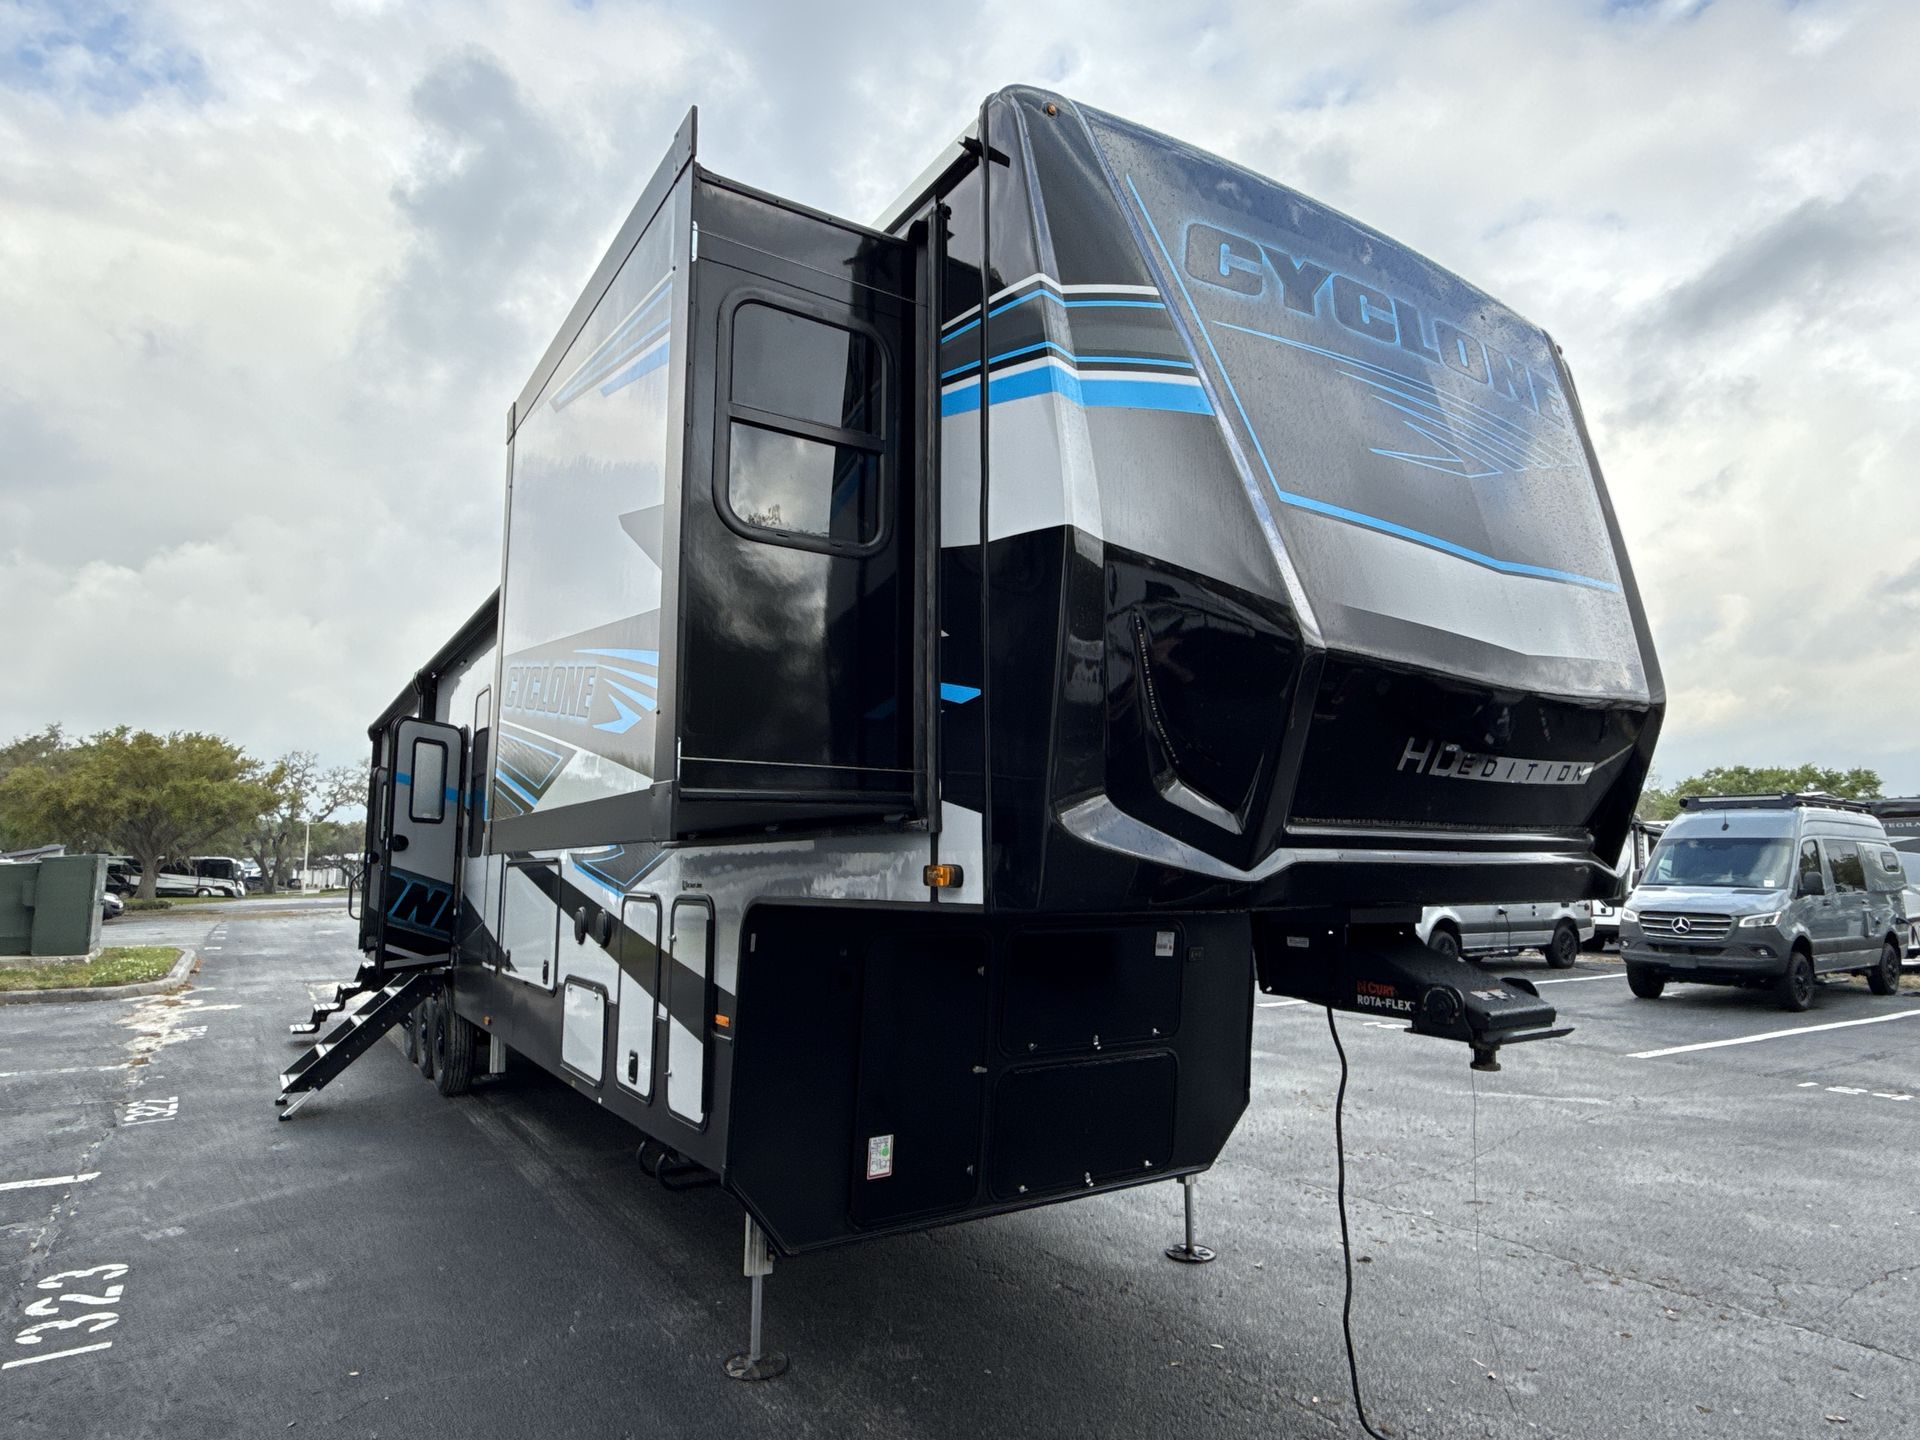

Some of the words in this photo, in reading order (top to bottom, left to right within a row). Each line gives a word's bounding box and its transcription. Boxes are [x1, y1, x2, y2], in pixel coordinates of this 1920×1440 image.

[504, 665, 597, 718] CYCLONE
[1396, 736, 1463, 777] HD
[1457, 756, 1587, 783] EDITION
[1357, 994, 1412, 1012] ROTA-FLEX
[1, 1263, 129, 1370] 1323
